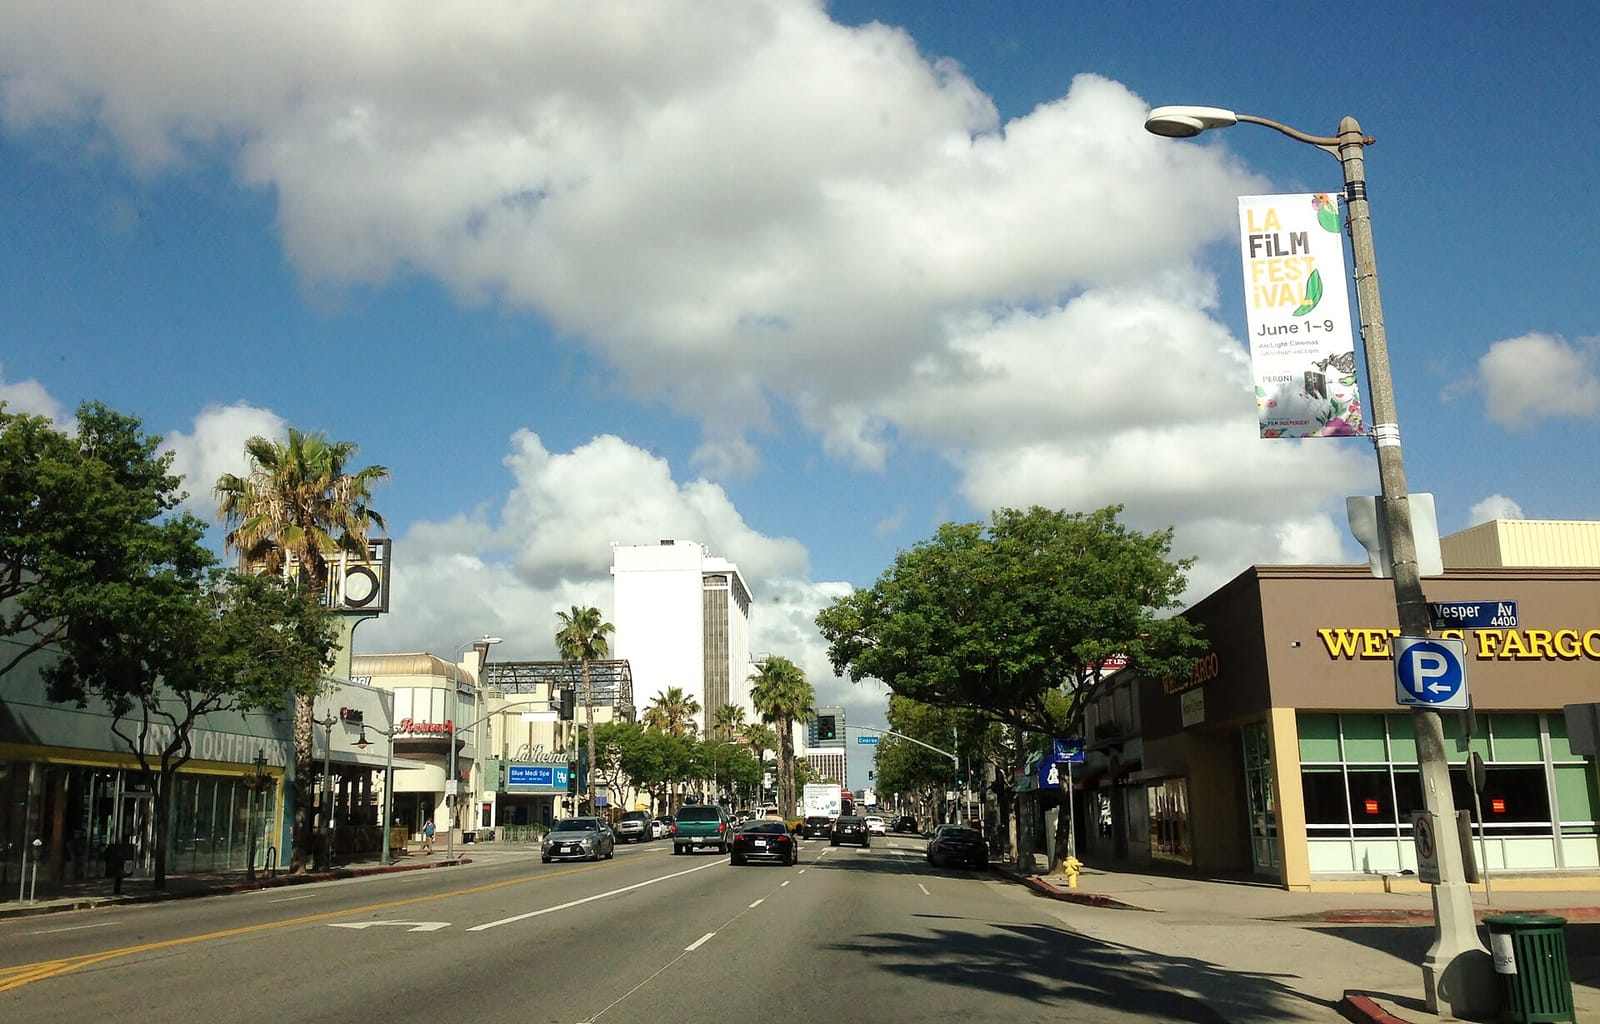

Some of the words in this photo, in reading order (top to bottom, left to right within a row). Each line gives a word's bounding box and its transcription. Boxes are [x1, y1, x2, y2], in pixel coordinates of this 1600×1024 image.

[1247, 208, 1282, 232] LA
[1251, 256, 1316, 283] FEST
[1257, 323, 1299, 337] June
[1289, 339, 1319, 348] Cinemas
[1262, 375, 1293, 383] PERONI
[1433, 603, 1480, 620] Vesper
[1497, 602, 1513, 617] Av
[1490, 615, 1517, 627] 4400
[1411, 650, 1448, 693] P
[203, 730, 288, 767] OUTFITTERS
[511, 743, 529, 762] La
[533, 744, 568, 763] Reina
[539, 769, 550, 777] Spa
